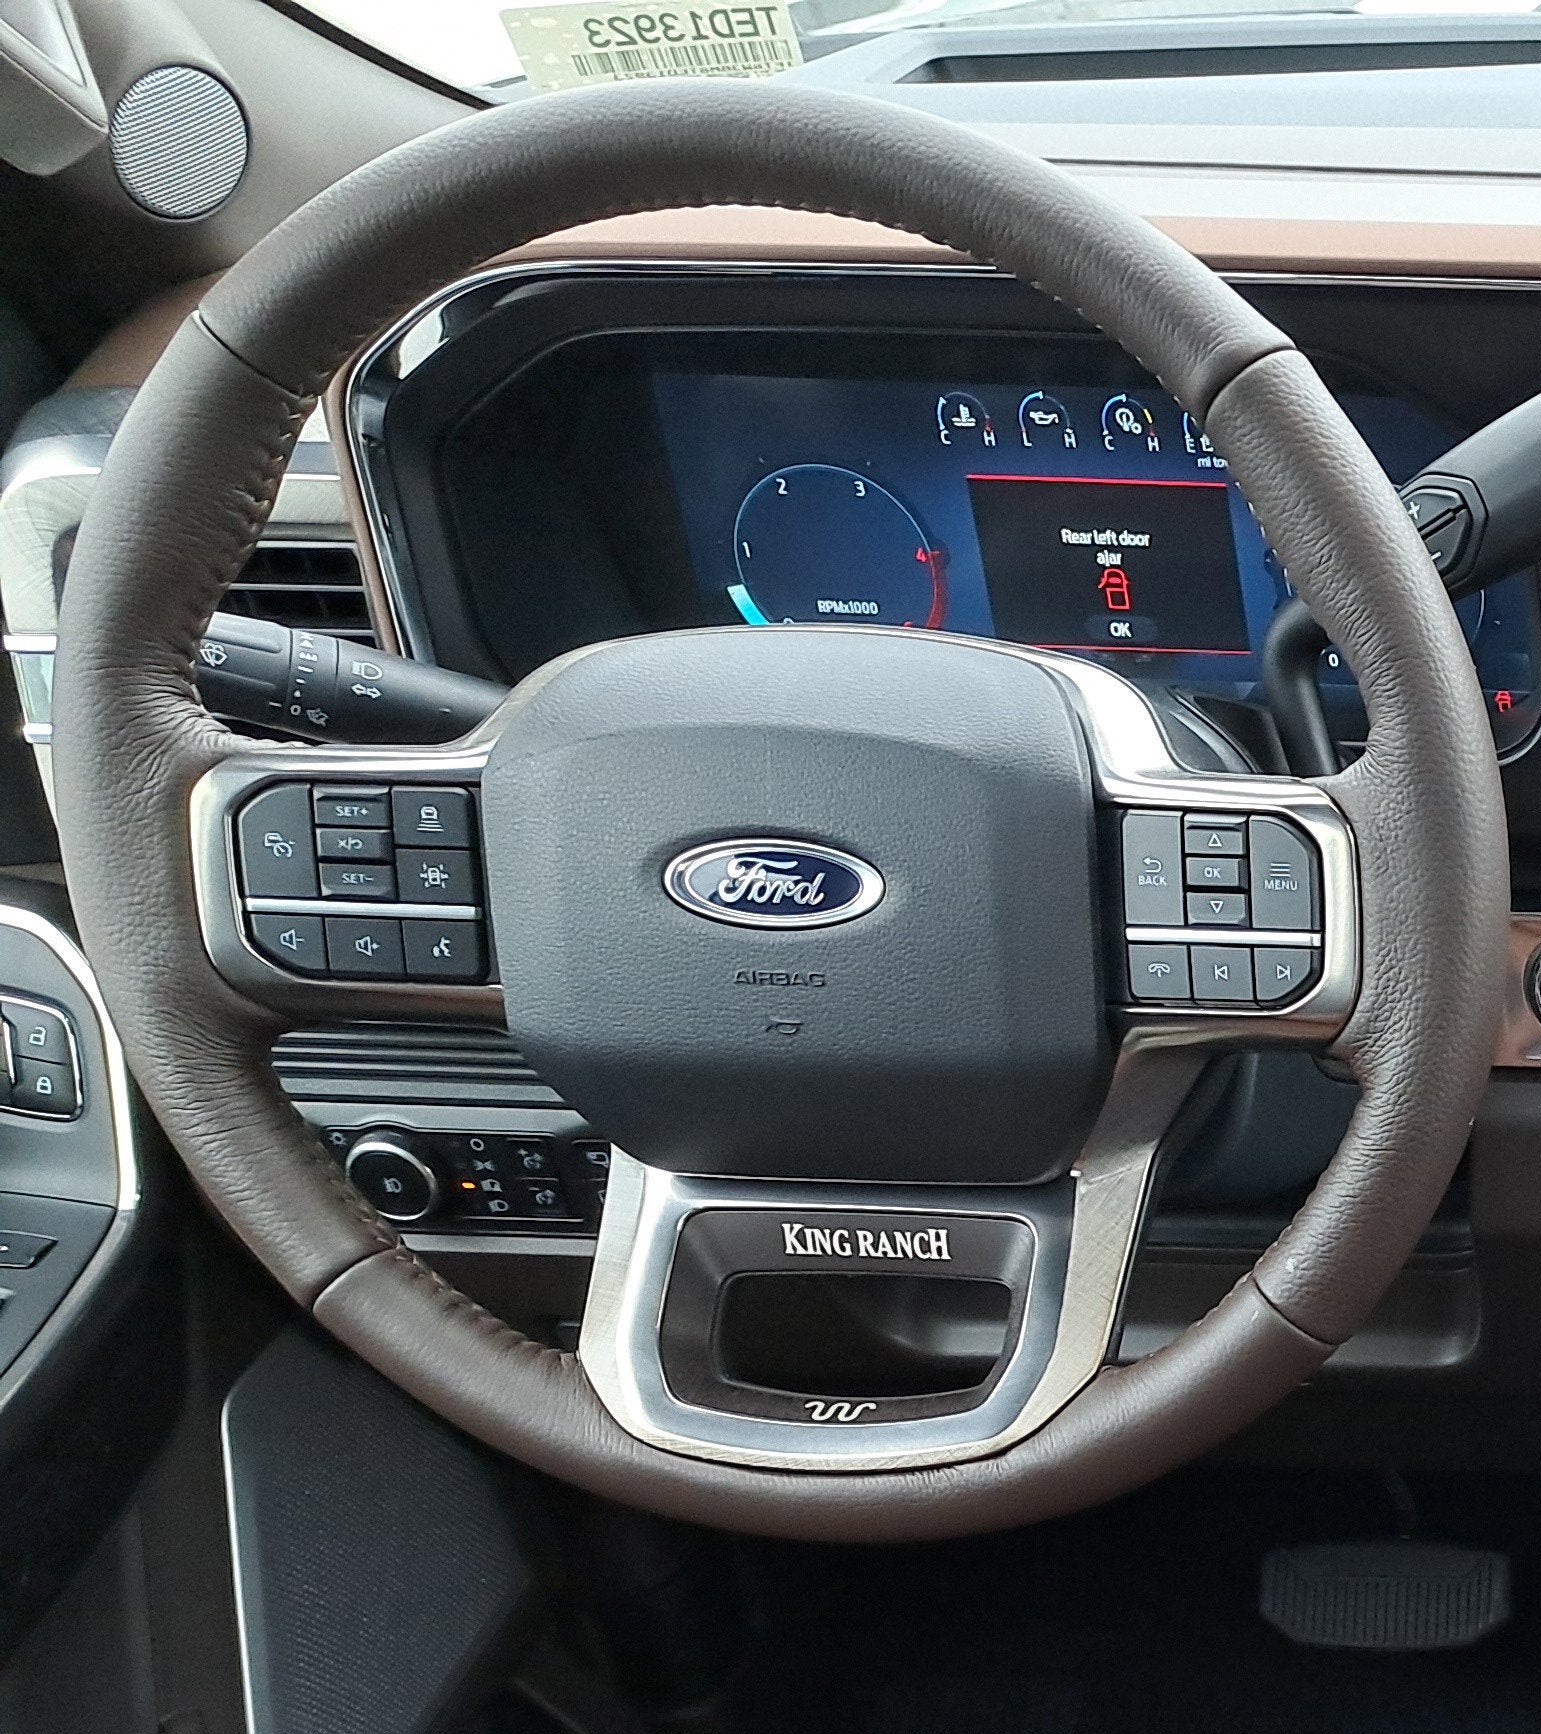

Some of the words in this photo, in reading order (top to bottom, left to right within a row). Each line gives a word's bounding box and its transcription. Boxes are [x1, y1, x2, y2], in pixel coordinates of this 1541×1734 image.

[941, 429, 951, 445] C
[984, 431, 996, 446] H
[1022, 430, 1032, 446] L
[1065, 433, 1077, 448] H
[1104, 435, 1115, 450] C
[1147, 436, 1160, 451] H
[776, 478, 788, 495] 2
[853, 481, 866, 497] 3
[1061, 529, 1092, 546] Rear
[1094, 530, 1118, 545] left
[1119, 531, 1150, 546] door
[742, 541, 751, 559] 1
[916, 547, 927, 563] 4
[1096, 549, 1122, 567] ajar
[817, 600, 879, 615] RPMx1000
[1110, 622, 1132, 638] OK
[1328, 653, 1339, 667] 0
[335, 805, 370, 818] SET+
[718, 857, 825, 905] Ford
[1204, 867, 1221, 879] OK
[1138, 876, 1167, 887] BACK
[1264, 880, 1298, 892] MENU
[733, 969, 826, 988] AIRBAG
[782, 1223, 852, 1257] KING
[859, 1227, 951, 1261] RANCH
